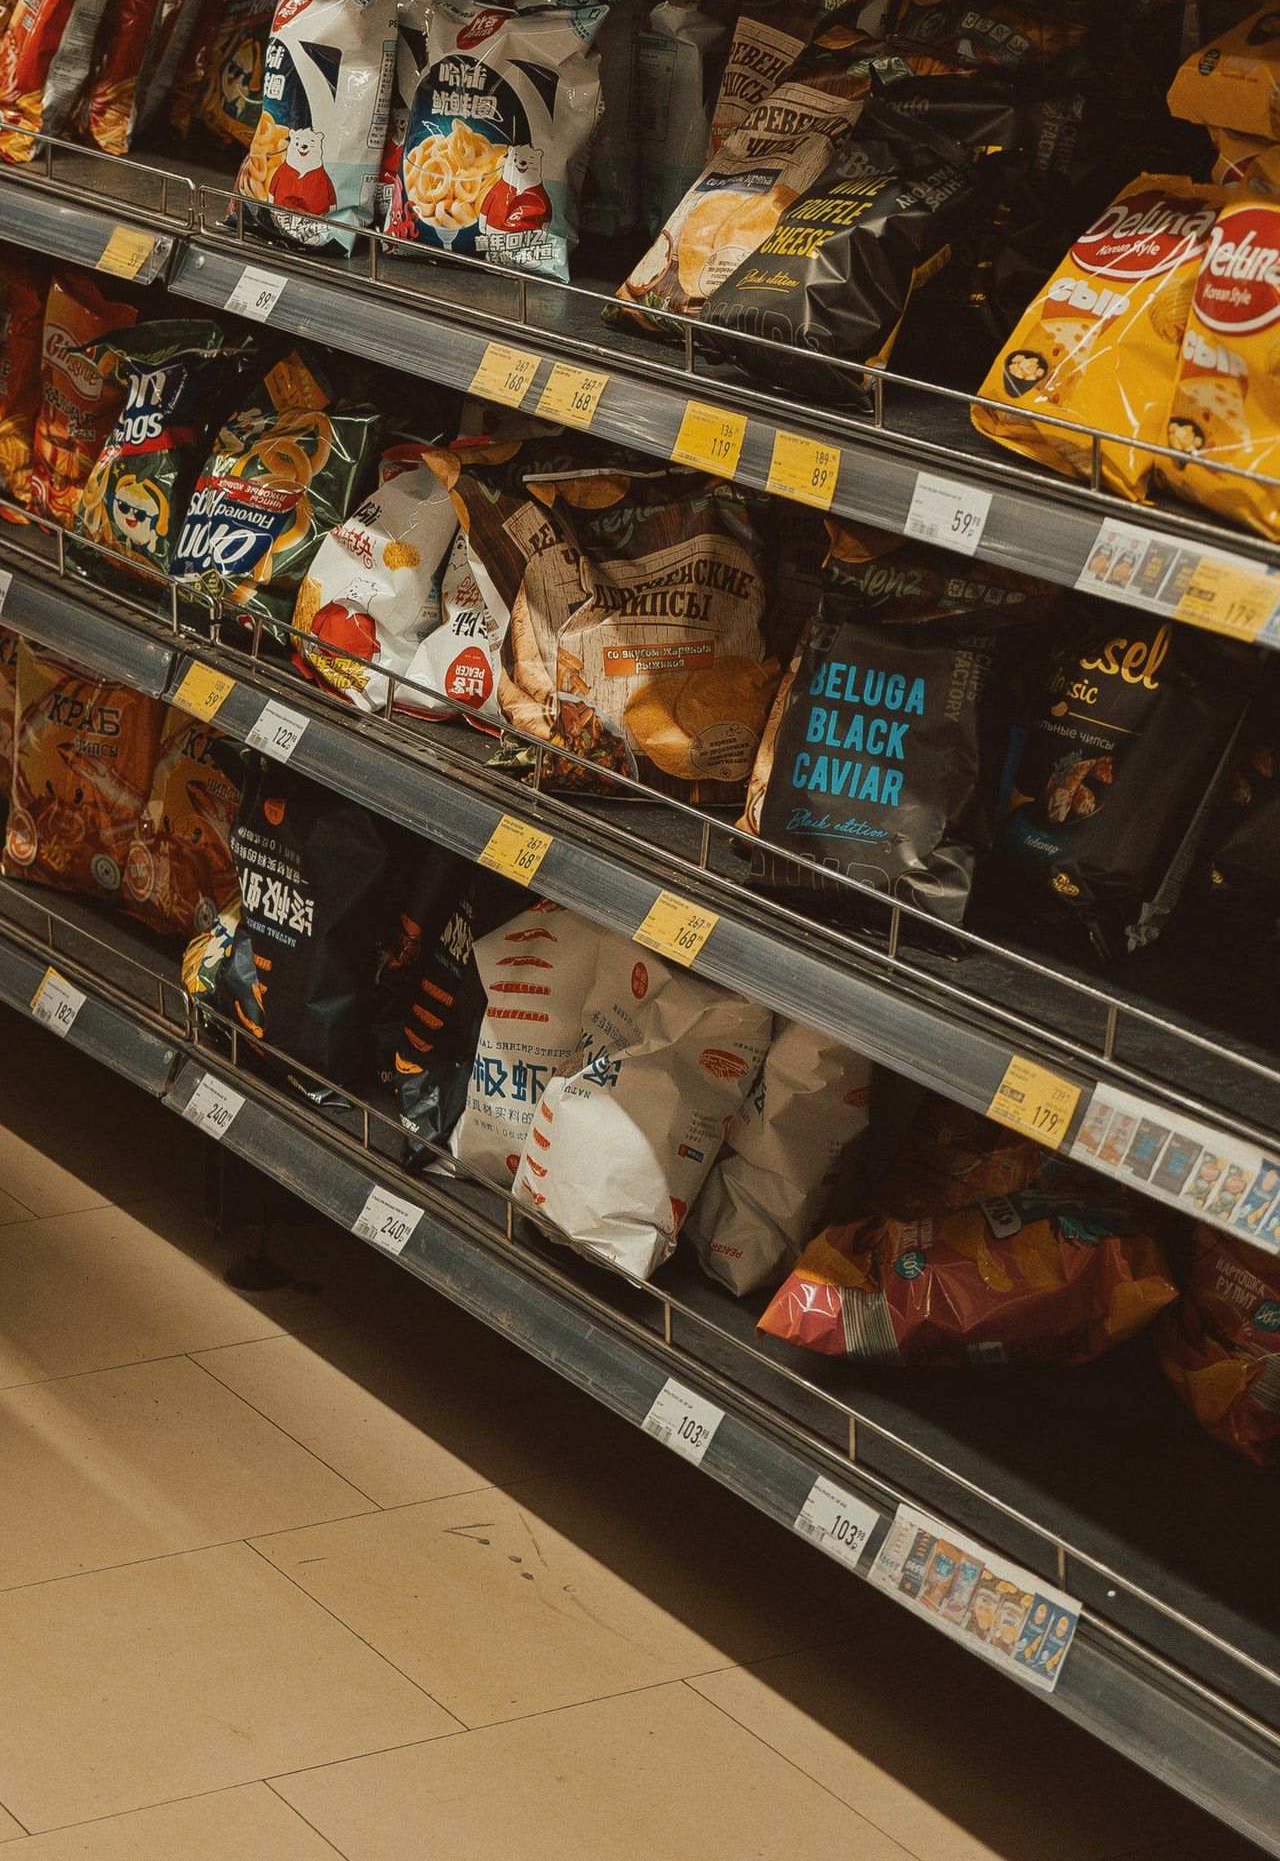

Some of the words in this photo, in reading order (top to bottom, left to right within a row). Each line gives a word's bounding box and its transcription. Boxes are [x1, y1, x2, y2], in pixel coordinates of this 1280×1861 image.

[785, 198, 874, 227] TRUFFLE
[1076, 201, 1217, 244] Deluna
[759, 225, 836, 260] CHEESE
[118, 412, 164, 446] ngs
[606, 649, 619, 661] со
[621, 646, 660, 662] вкусом
[635, 658, 686, 674] рыжиков
[454, 664, 486, 679] PEACER
[808, 660, 926, 716] BELUGA
[48, 693, 121, 738] КРАБ
[805, 706, 911, 761] BLACK
[791, 752, 905, 808] CAVIAR
[514, 848, 533, 870] 168
[240, 866, 316, 938] 终极虾
[687, 915, 705, 930] 267
[674, 927, 698, 950] 168
[55, 999, 71, 1022] 182
[496, 1041, 534, 1054] SHRIMP
[534, 1046, 572, 1058] STRIPS
[473, 1055, 549, 1105] 极虾
[206, 1102, 225, 1127] 240
[1031, 1105, 1059, 1133] 179
[380, 1215, 403, 1241] 240
[677, 1415, 703, 1444] 103
[830, 1514, 859, 1547] 103
